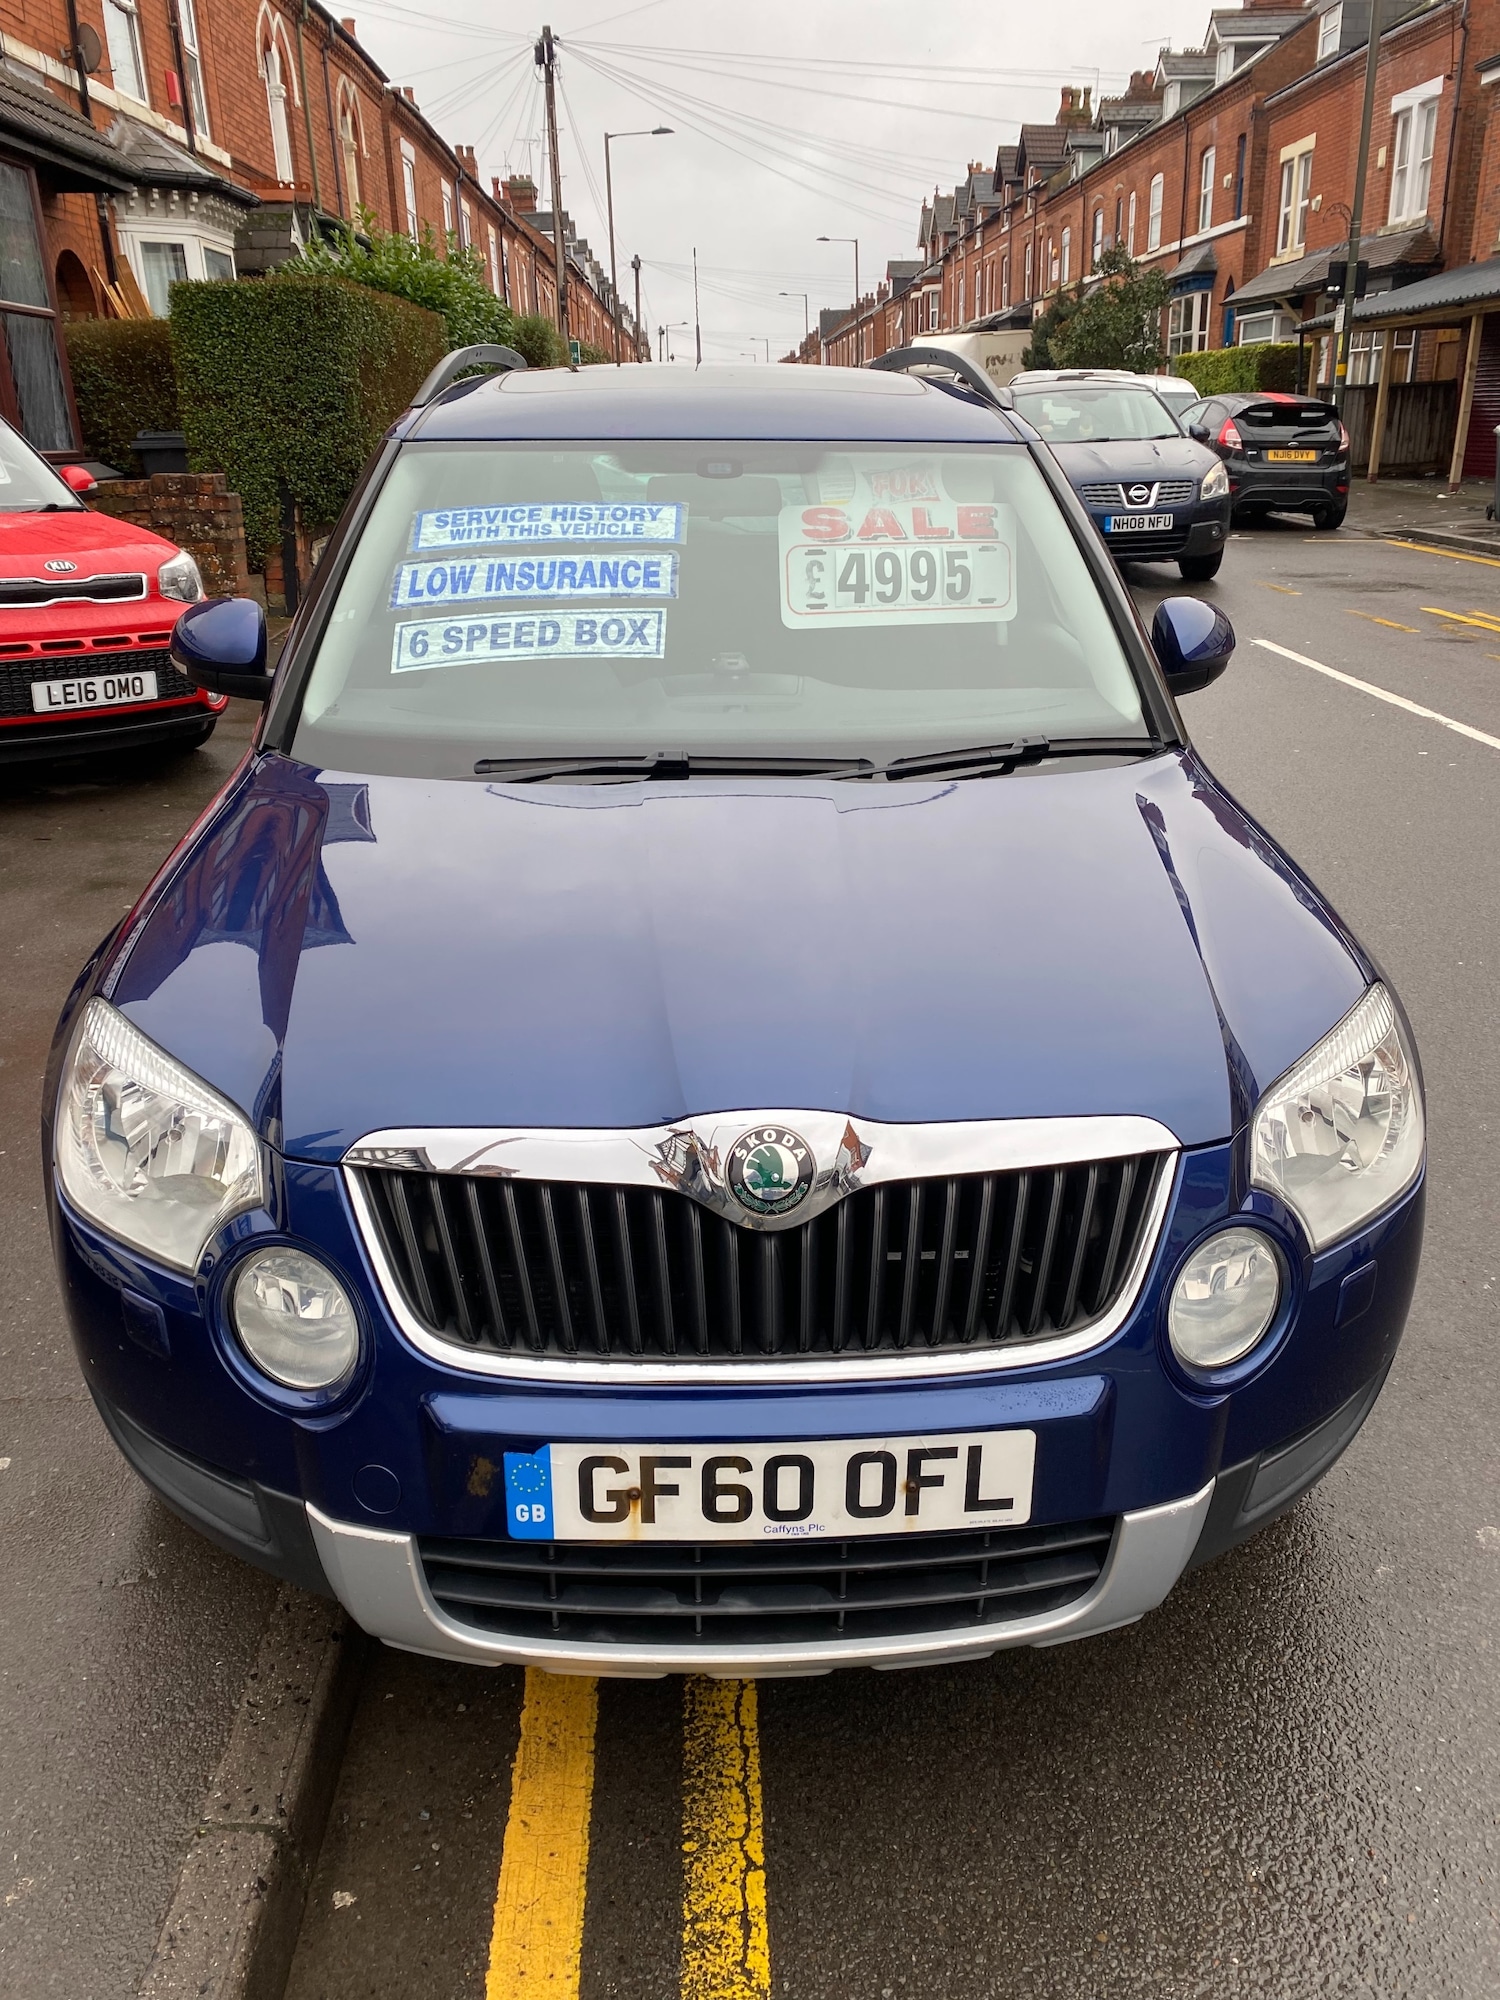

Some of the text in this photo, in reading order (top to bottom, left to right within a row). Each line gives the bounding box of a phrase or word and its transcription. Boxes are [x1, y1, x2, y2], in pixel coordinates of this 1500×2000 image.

[1273, 451, 1310, 459] NJ16 DVY
[434, 507, 663, 530] SERVICE HISTORY
[801, 506, 998, 542] SALE
[1113, 518, 1145, 530] NH08
[1148, 516, 1172, 528] NFU
[450, 523, 645, 541] WITH THIS VEHICLE
[50, 561, 74, 570] KIA
[407, 560, 662, 598] LOW INSURANCE
[409, 618, 651, 658] 6 SPEED BOX
[46, 676, 144, 706] LE16 OMO
[578, 1445, 1014, 1523] GF60 OFL
[515, 1504, 546, 1522] GB
[763, 1525, 805, 1535] Caffyns
[808, 1524, 825, 1532] Plc
